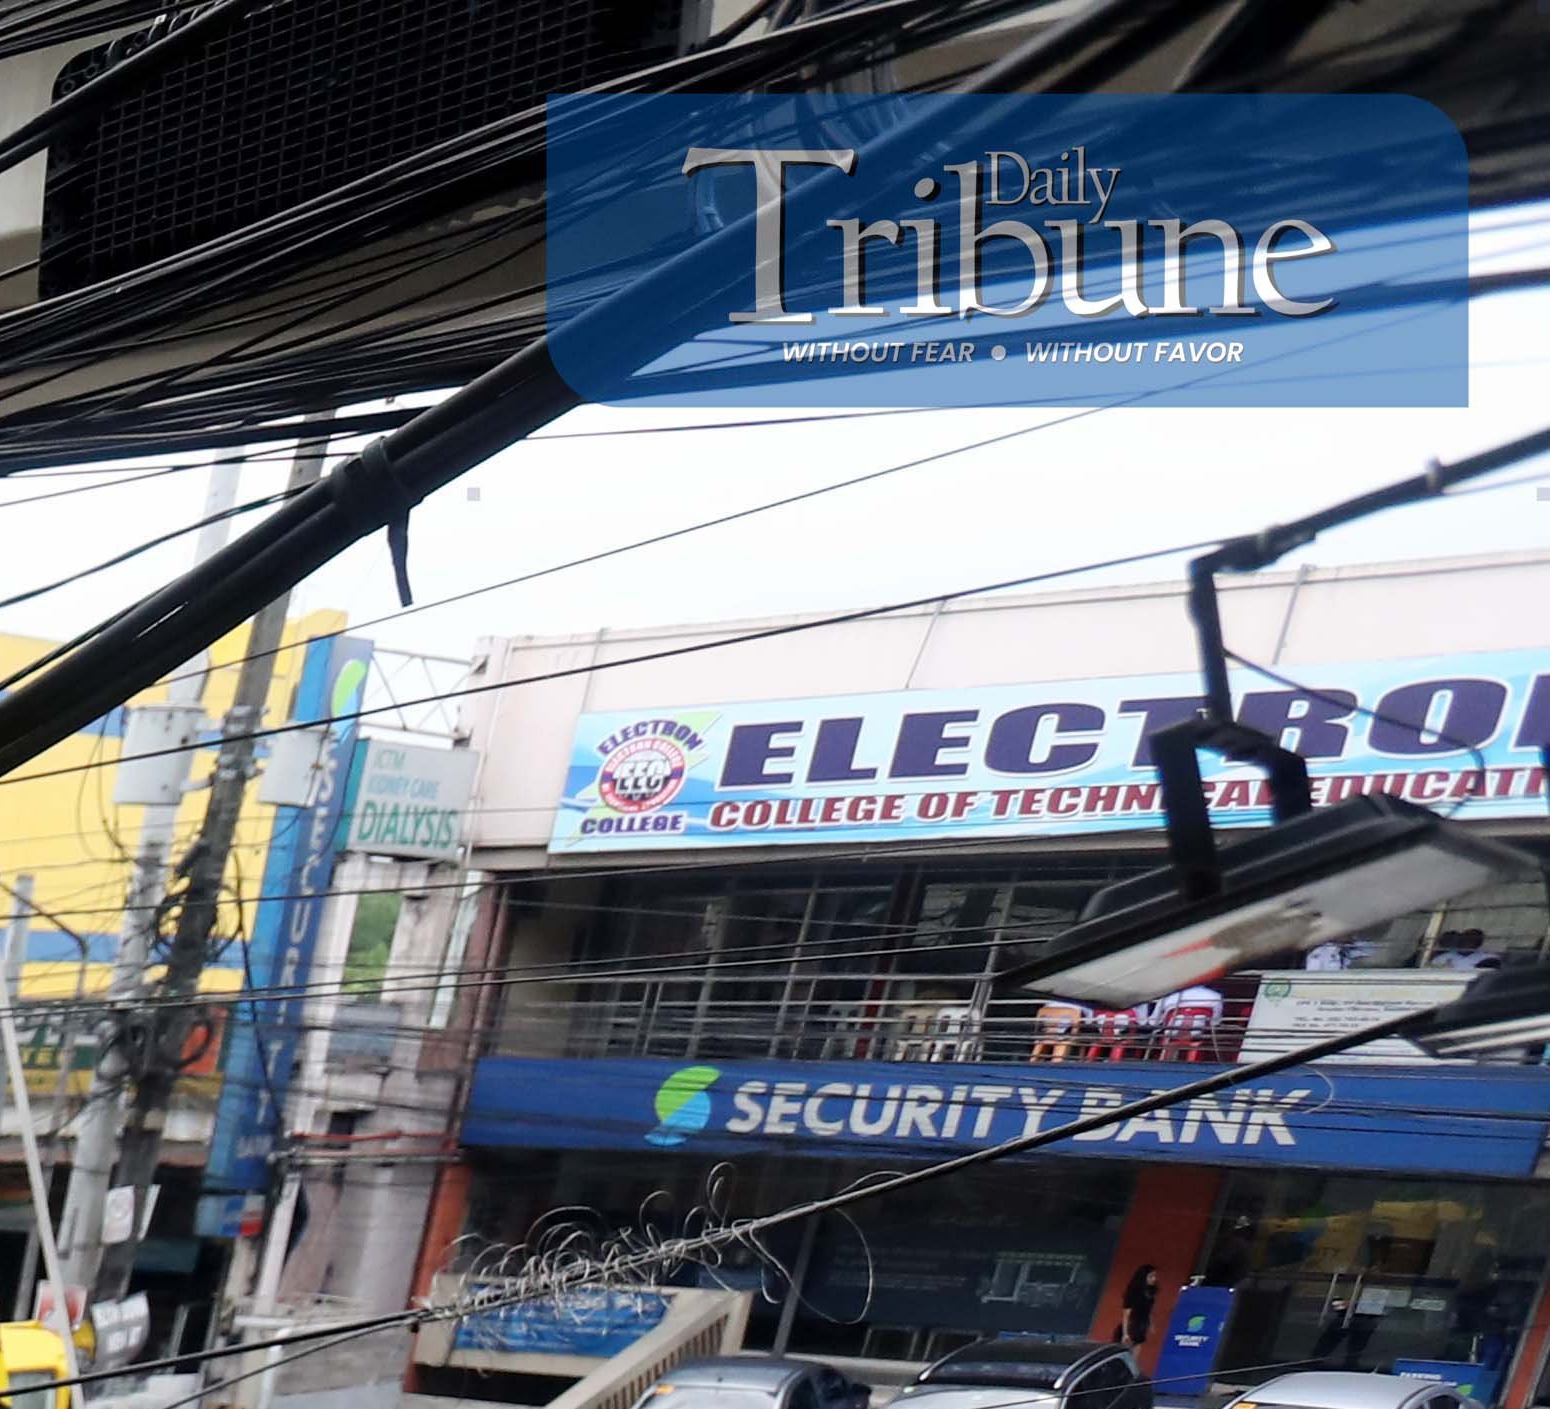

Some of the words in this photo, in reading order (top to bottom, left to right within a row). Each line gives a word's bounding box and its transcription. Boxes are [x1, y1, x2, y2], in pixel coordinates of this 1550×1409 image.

[598, 719, 703, 756] ELECTRON
[357, 800, 459, 850] DIALYSIS
[580, 814, 684, 835] COLLEGE
[707, 787, 906, 830] COLLEGE
[918, 790, 977, 819] OF
[725, 1081, 1071, 1141] SECURITY
[1067, 1087, 1313, 1146] BANK
